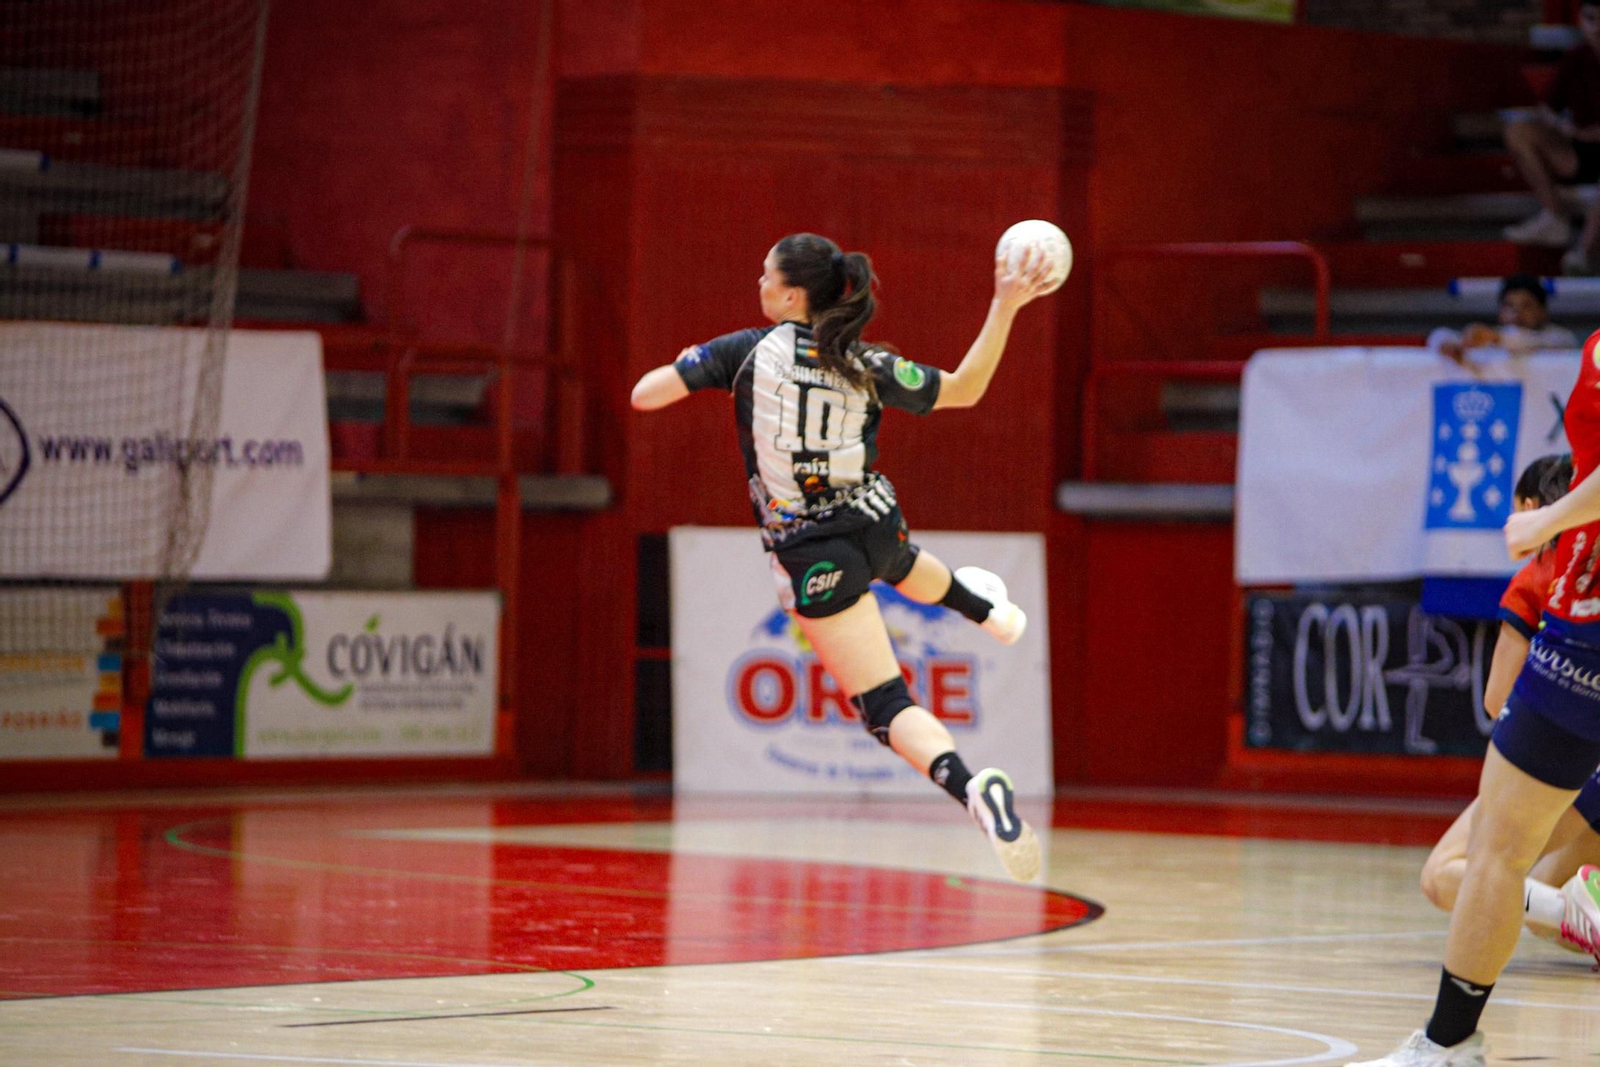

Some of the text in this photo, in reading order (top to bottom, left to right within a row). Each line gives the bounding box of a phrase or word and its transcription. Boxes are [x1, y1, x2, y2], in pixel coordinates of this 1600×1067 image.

[774, 382, 846, 451] 10
[806, 570, 843, 596] CSIF
[738, 656, 972, 724] ORE
